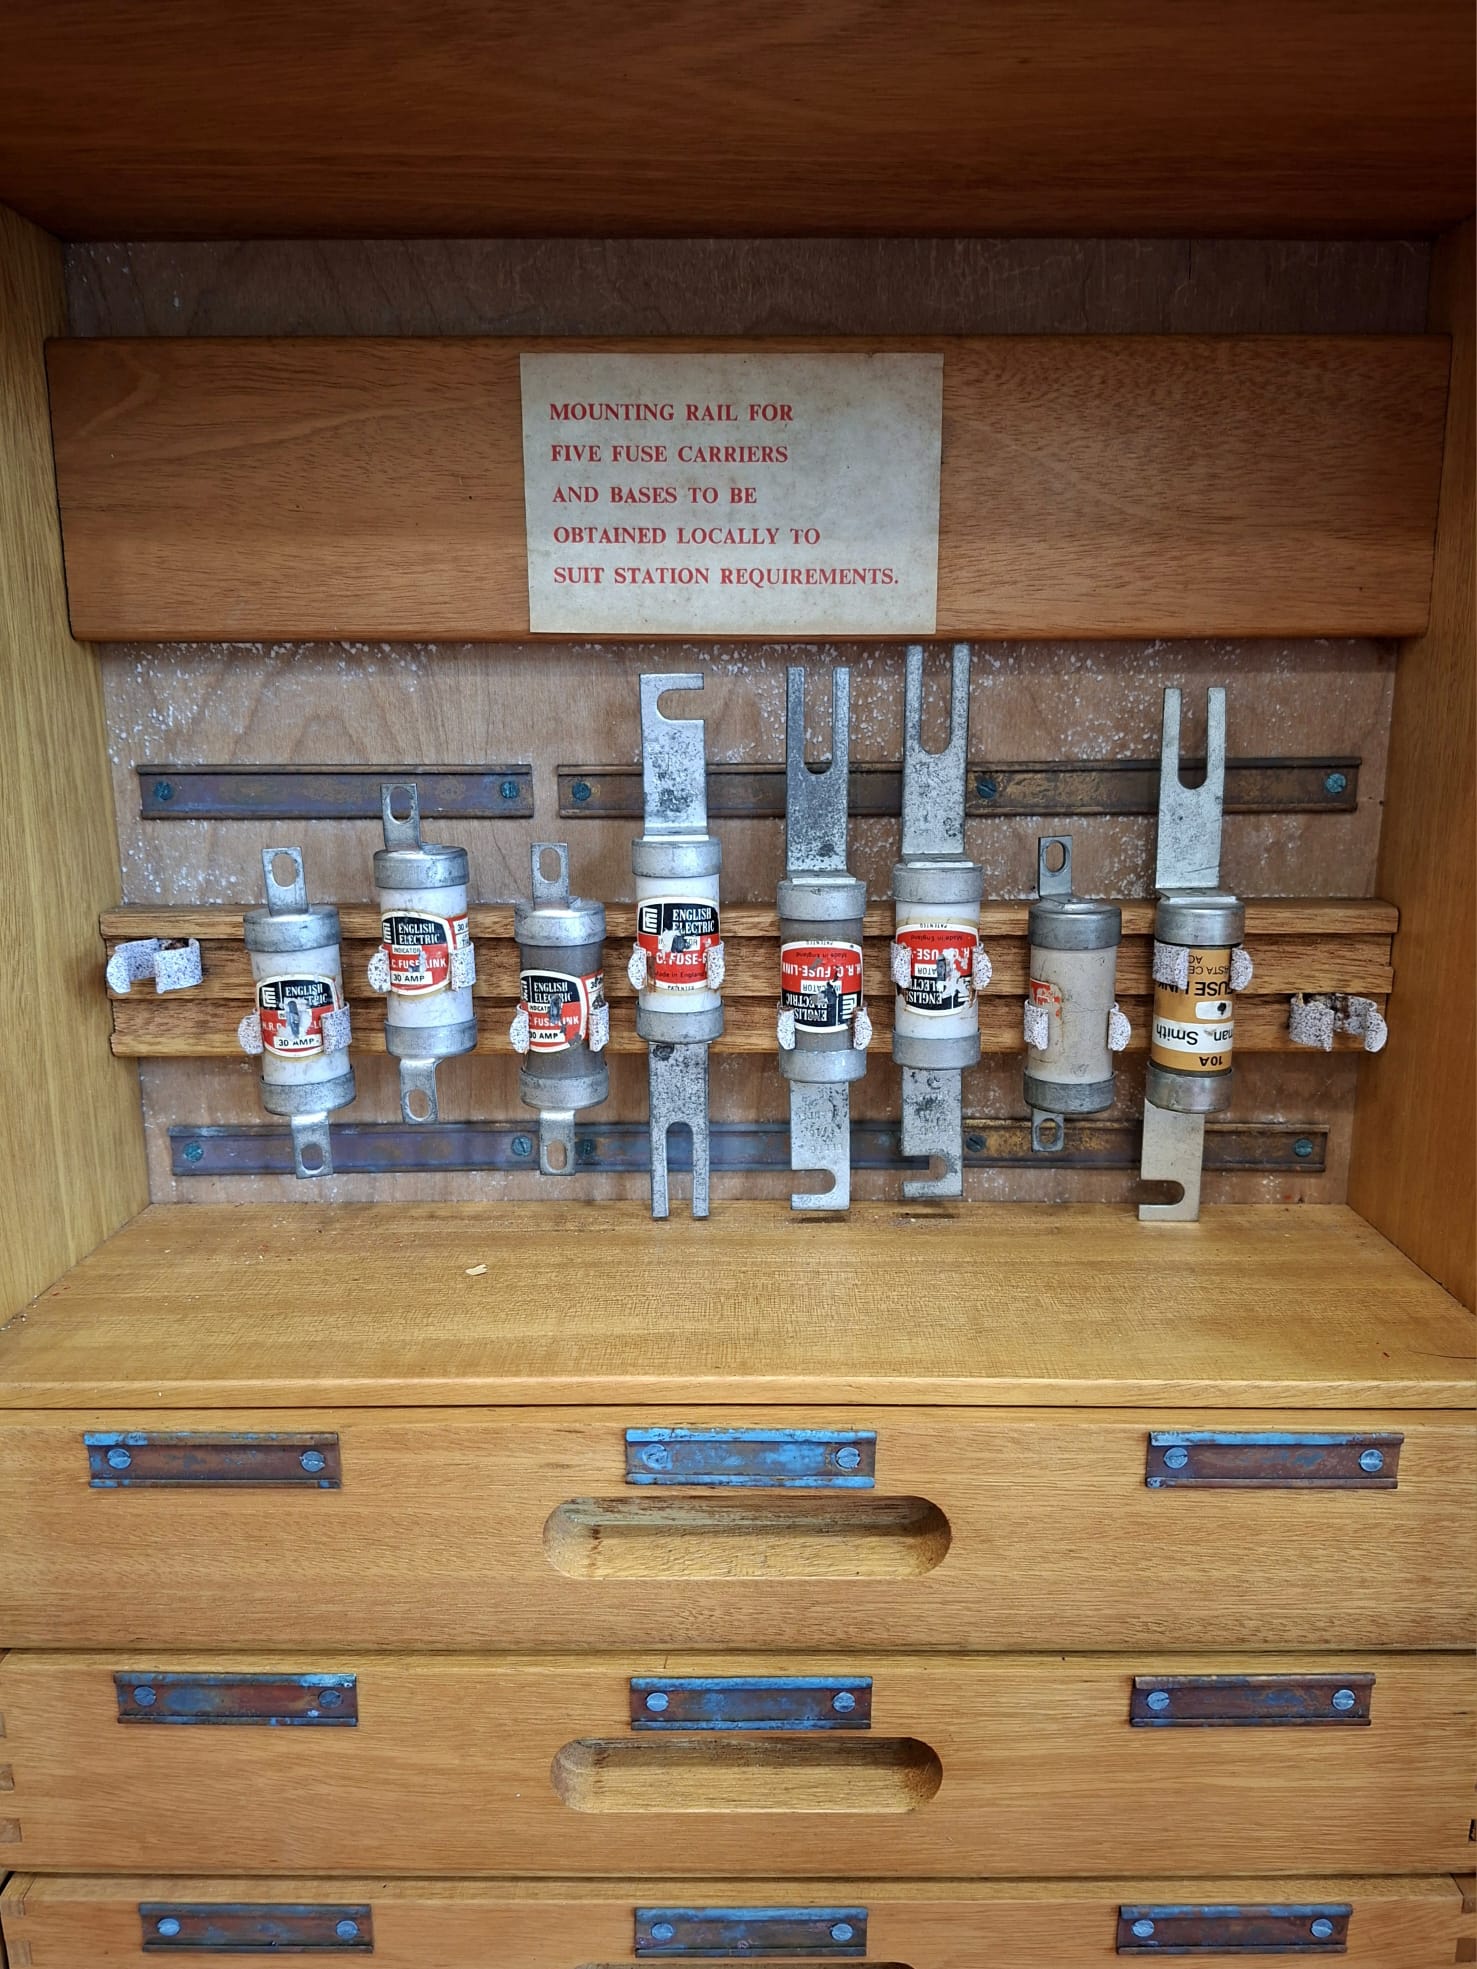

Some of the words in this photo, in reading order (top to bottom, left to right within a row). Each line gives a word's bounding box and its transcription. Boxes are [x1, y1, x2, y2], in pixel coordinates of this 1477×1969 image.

[550, 403, 674, 421] MOUNTING
[686, 403, 738, 421] RAIL
[749, 404, 793, 422] FOR
[551, 445, 601, 462] FIVE
[611, 446, 667, 463] FUSE
[678, 446, 788, 463] CARRIERS
[552, 487, 599, 504] AND
[610, 487, 677, 504] BASES
[688, 487, 719, 504] TO
[730, 487, 757, 505] BE
[553, 527, 667, 545] OBTAINED
[677, 528, 779, 545] LOCALLY
[790, 529, 820, 545] TO
[554, 567, 604, 585] SUIT
[614, 568, 710, 585] STATION
[720, 568, 899, 589] REQUIREMENTS.
[672, 907, 712, 921] ENGLISH
[398, 923, 435, 934] ENGLISH
[672, 920, 715, 934] ELECTRIC
[399, 933, 440, 945] ELECTRIC
[393, 974, 402, 982] 30
[404, 974, 425, 982] AMP
[285, 984, 324, 997] ENGLISH
[533, 981, 568, 993] ENGLISH
[802, 984, 841, 992] INCATOR
[534, 992, 572, 1003] ELERIC
[794, 1008, 828, 1021] ENGLIS
[1156, 1023, 1199, 1046] Smith
[278, 1039, 289, 1047] 30
[292, 1038, 315, 1046] AMP
